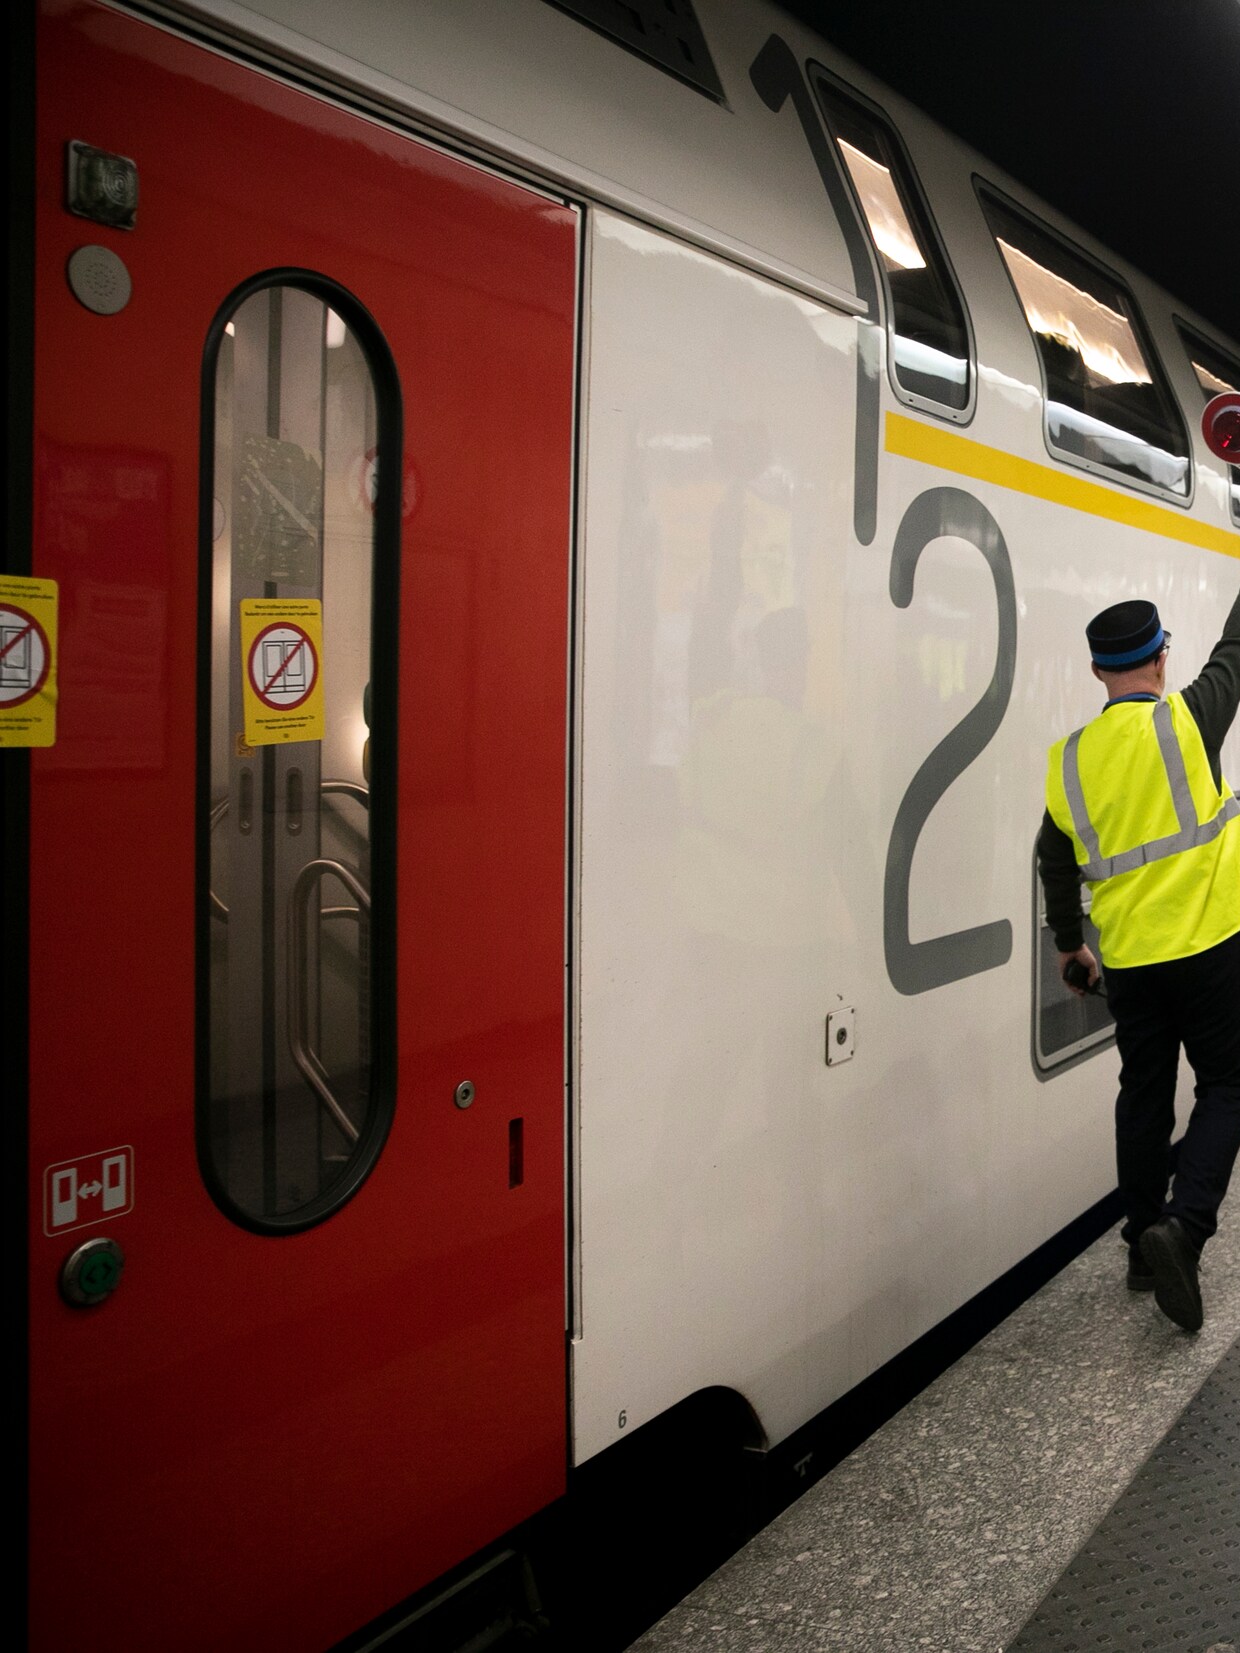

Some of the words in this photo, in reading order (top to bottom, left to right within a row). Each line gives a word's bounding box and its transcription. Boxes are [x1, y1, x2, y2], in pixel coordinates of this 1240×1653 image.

[750, 34, 880, 546] 1
[884, 486, 1015, 995] 2
[618, 1409, 627, 1429] 6
